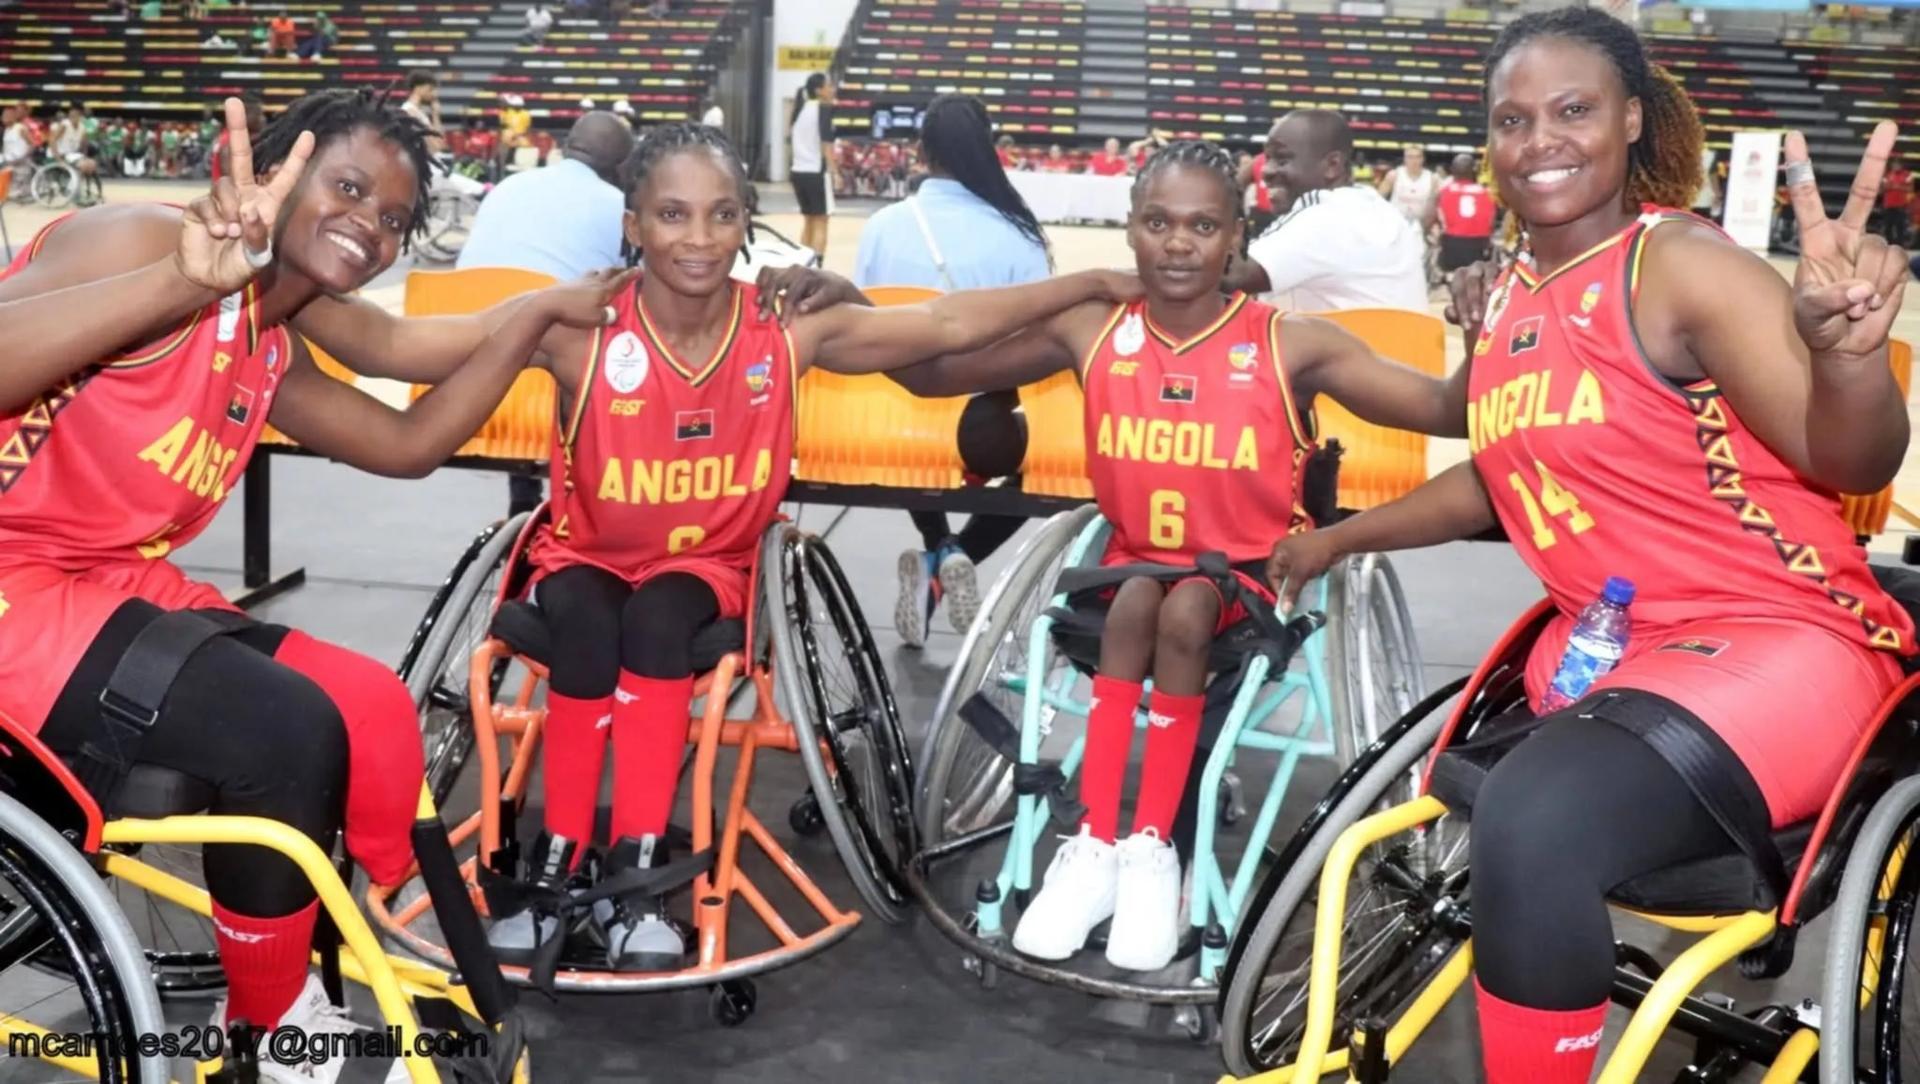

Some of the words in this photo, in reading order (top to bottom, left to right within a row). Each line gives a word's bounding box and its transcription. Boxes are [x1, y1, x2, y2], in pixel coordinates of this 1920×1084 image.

[1097, 413, 1259, 471] ANGOLA
[597, 448, 772, 504] ANGOLA
[1508, 459, 1596, 551] 14
[1150, 489, 1186, 549] 6
[1554, 1025, 1605, 1053] FAS
